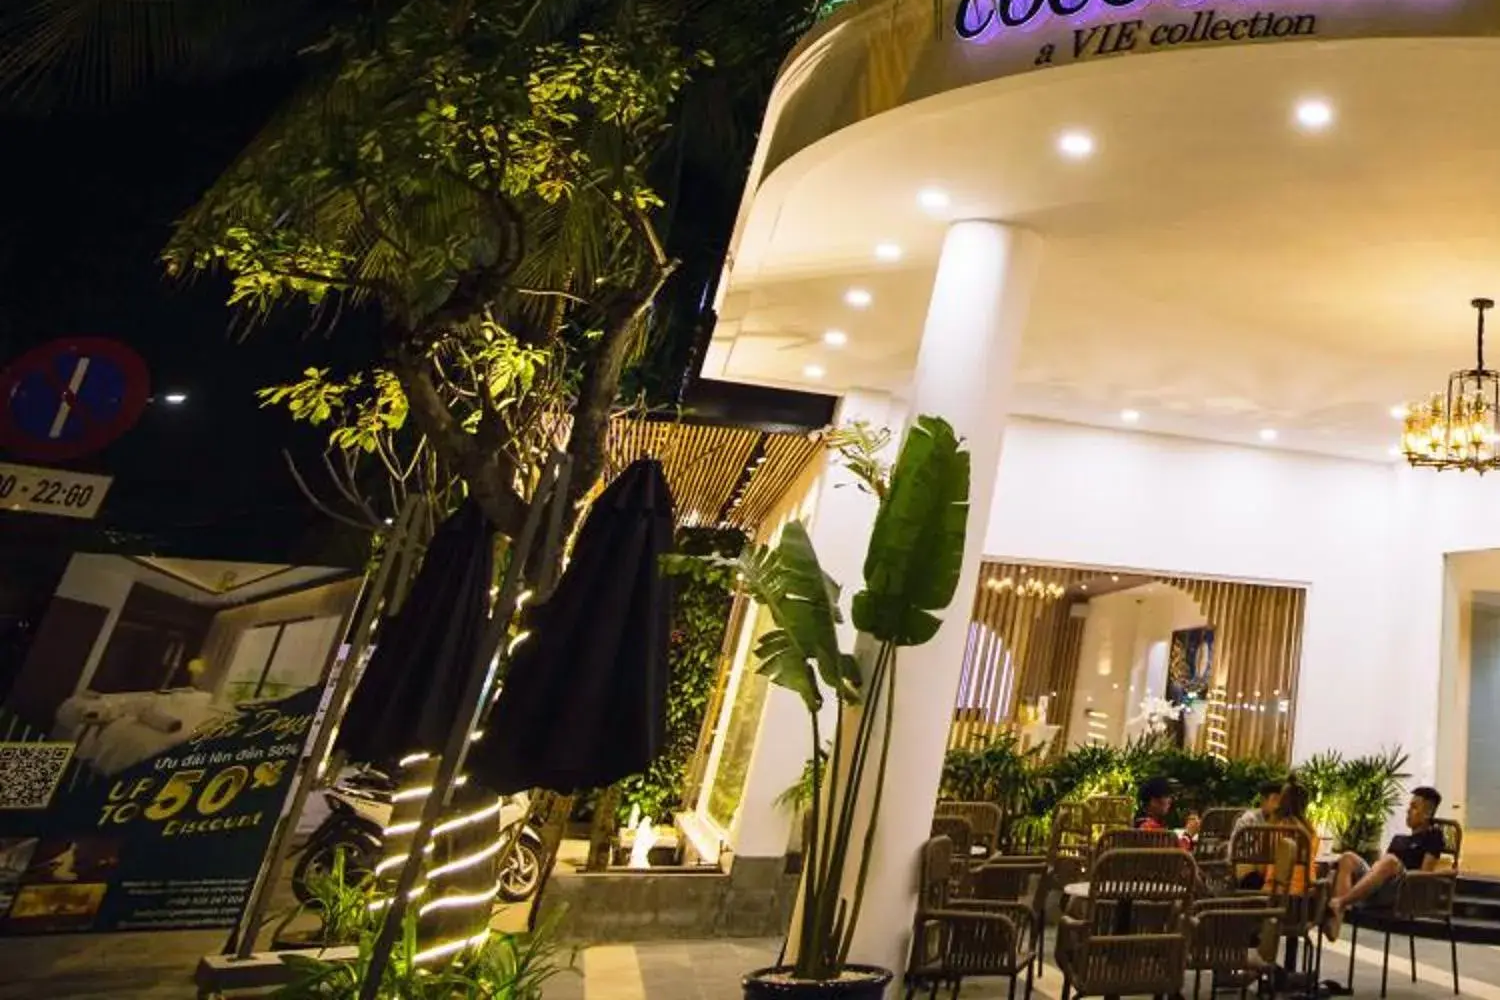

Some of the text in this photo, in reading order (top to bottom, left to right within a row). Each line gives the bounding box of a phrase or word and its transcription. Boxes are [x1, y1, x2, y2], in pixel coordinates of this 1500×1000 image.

[1034, 9, 1317, 66] a VIE collection
[30, 479, 95, 509] 22:00
